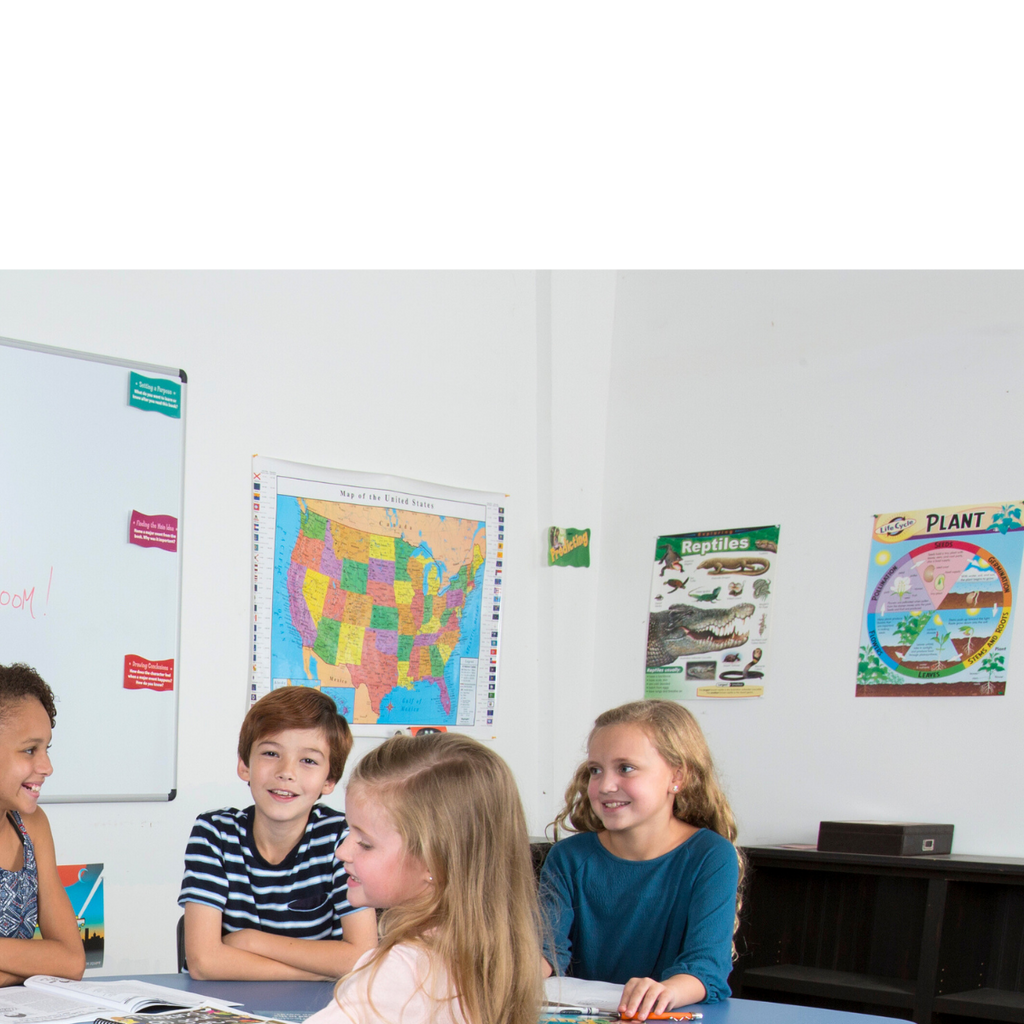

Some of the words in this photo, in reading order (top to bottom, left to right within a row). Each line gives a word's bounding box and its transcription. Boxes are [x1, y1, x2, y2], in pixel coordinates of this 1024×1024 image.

[340, 490, 354, 499] Map
[384, 494, 408, 504] United
[412, 499, 434, 508] States
[880, 525, 894, 533] Life
[894, 520, 914, 528] Cycle
[926, 512, 986, 532] PLANT
[550, 532, 588, 563] Predicting
[682, 538, 749, 554] Reptiles
[872, 566, 898, 601] POLLINATION
[988, 556, 1010, 593] GERMINATION
[968, 648, 988, 664] STEMS
[987, 635, 998, 648] AND
[996, 612, 1008, 633] ROOTS
